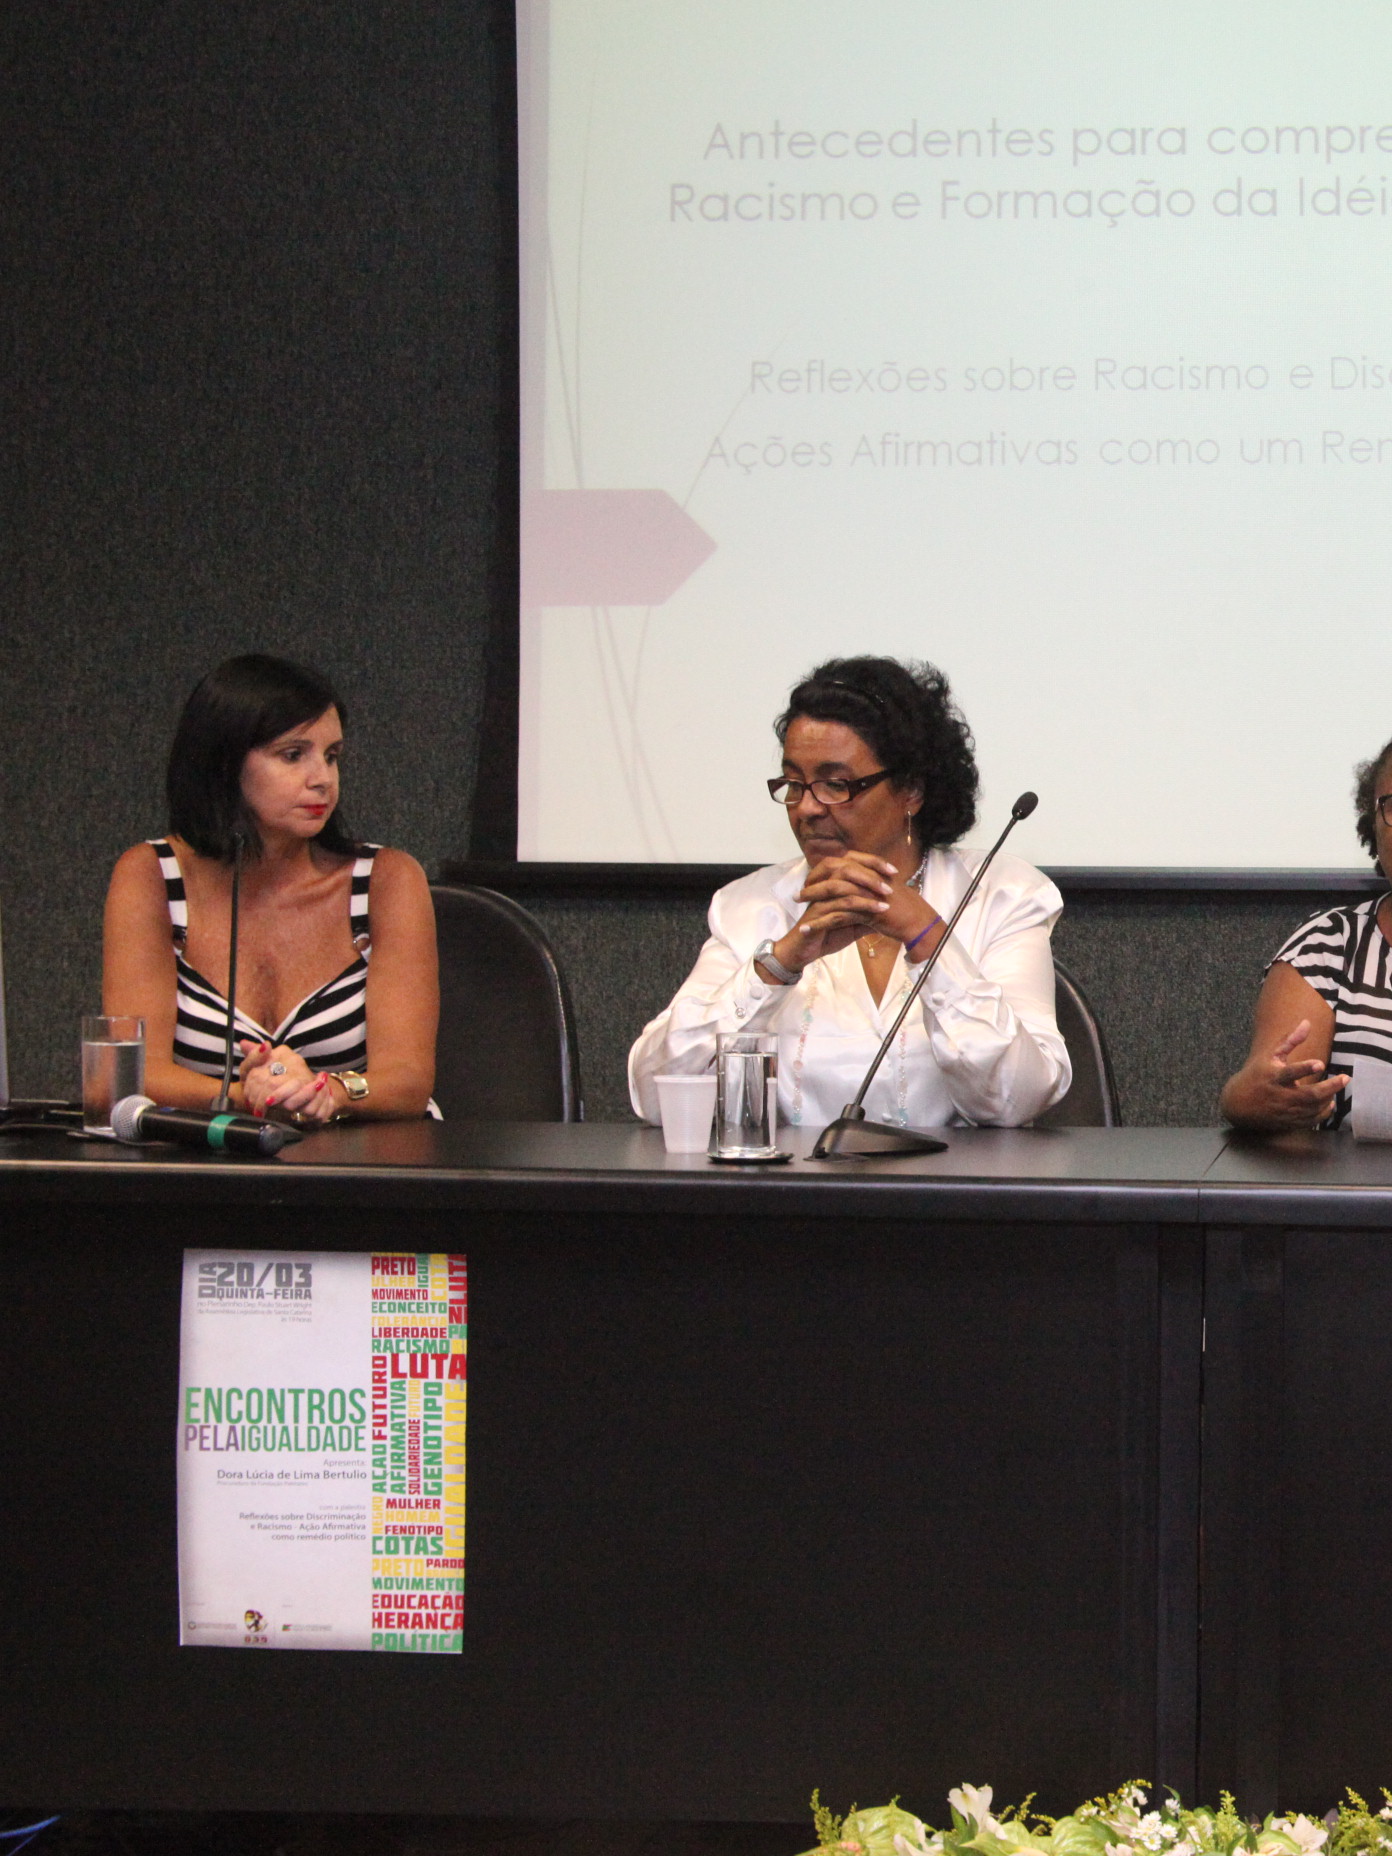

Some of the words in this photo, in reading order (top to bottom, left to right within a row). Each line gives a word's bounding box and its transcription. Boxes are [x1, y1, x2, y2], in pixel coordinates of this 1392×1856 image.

[703, 118, 1054, 160] Antecedentes
[1072, 126, 1187, 167] para
[669, 181, 879, 223] Racismo
[892, 191, 922, 221] e
[940, 179, 1196, 229] Formação
[1211, 177, 1278, 218] da
[750, 360, 947, 394] Reflexões
[964, 358, 1077, 393] sobre
[1094, 356, 1270, 391] Racismo
[1289, 364, 1314, 390] e
[702, 434, 832, 475] Ações
[853, 431, 1078, 467] Afirmativas
[1099, 438, 1220, 466] como
[1239, 438, 1303, 465] um
[217, 1262, 313, 1288] 20/03
[371, 1256, 416, 1276] PRETO
[198, 1262, 217, 1298] DIA
[217, 1288, 312, 1301] QUINTA-FEIRA
[371, 1288, 429, 1301] MOVIMENTO
[371, 1327, 448, 1339] LIBERDADE
[371, 1338, 450, 1354] RACISMO
[390, 1353, 467, 1380] LUTA
[184, 1387, 367, 1425] ENCONTROS
[372, 1355, 388, 1441] FUTURO
[184, 1424, 367, 1452] PELAIGUALDADE
[390, 1380, 406, 1495] AFIRMATIVA
[217, 1469, 243, 1480] Dora
[246, 1469, 274, 1480] Lúcia
[277, 1469, 291, 1480] de
[293, 1470, 320, 1480] Lima
[323, 1470, 367, 1480] Bertulio
[385, 1498, 441, 1510] MULHER
[239, 1512, 279, 1521] Reflexões
[281, 1512, 304, 1521] sobre
[306, 1512, 367, 1522] Discriminação
[385, 1510, 441, 1523] HOMEM
[257, 1523, 293, 1531] Racismo
[300, 1523, 320, 1532] Ação
[322, 1523, 366, 1531] Afirmativa
[296, 1533, 333, 1541] remédio
[372, 1535, 444, 1556] COTAS
[372, 1558, 426, 1577] PRETO
[426, 1558, 466, 1569] PARDO
[372, 1577, 465, 1591] MOVIMENTO
[372, 1592, 465, 1612] EDUCAÇÃO
[372, 1611, 464, 1633] HERANÇA
